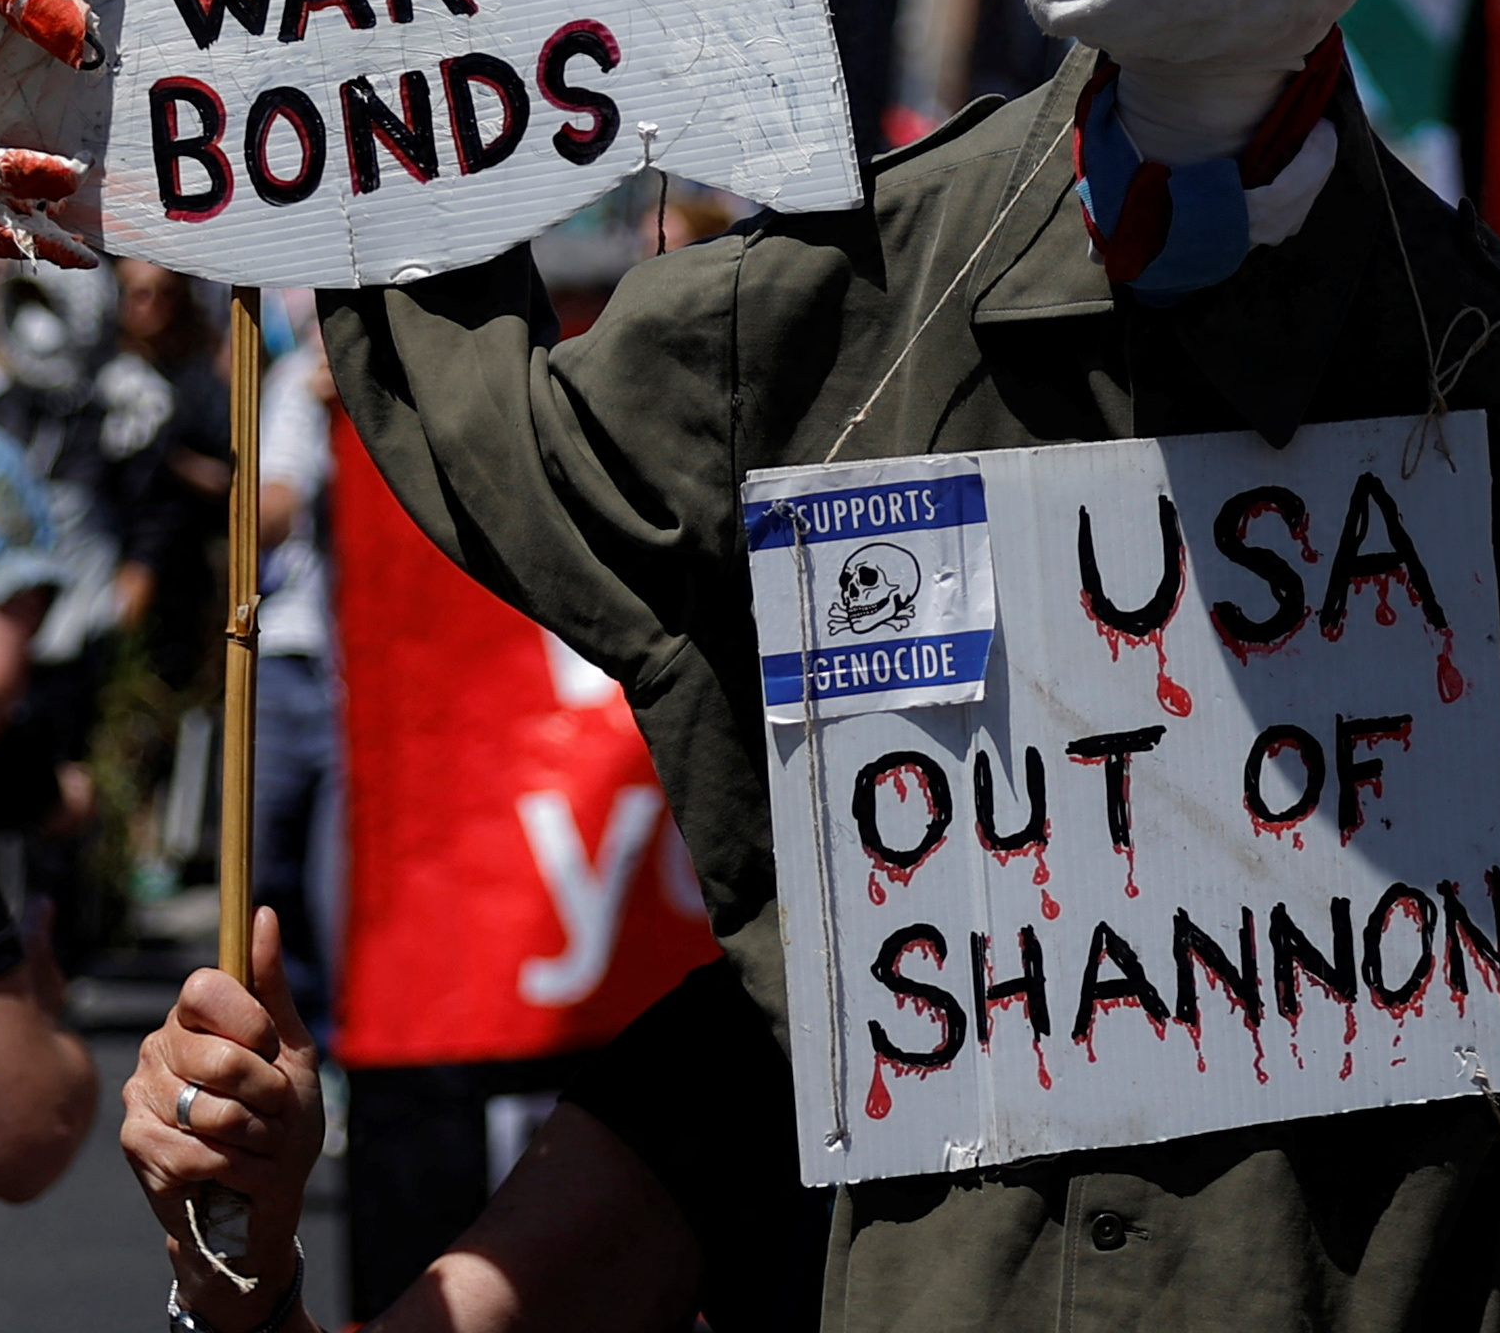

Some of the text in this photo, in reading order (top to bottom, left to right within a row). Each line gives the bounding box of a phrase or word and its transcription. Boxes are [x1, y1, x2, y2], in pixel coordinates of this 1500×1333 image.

[148, 18, 622, 223] BONDS
[796, 489, 937, 534] SUPPORTS
[1078, 472, 1450, 663] USA
[812, 642, 957, 692] GENOCIDE
[851, 713, 1414, 883] OUT OF
